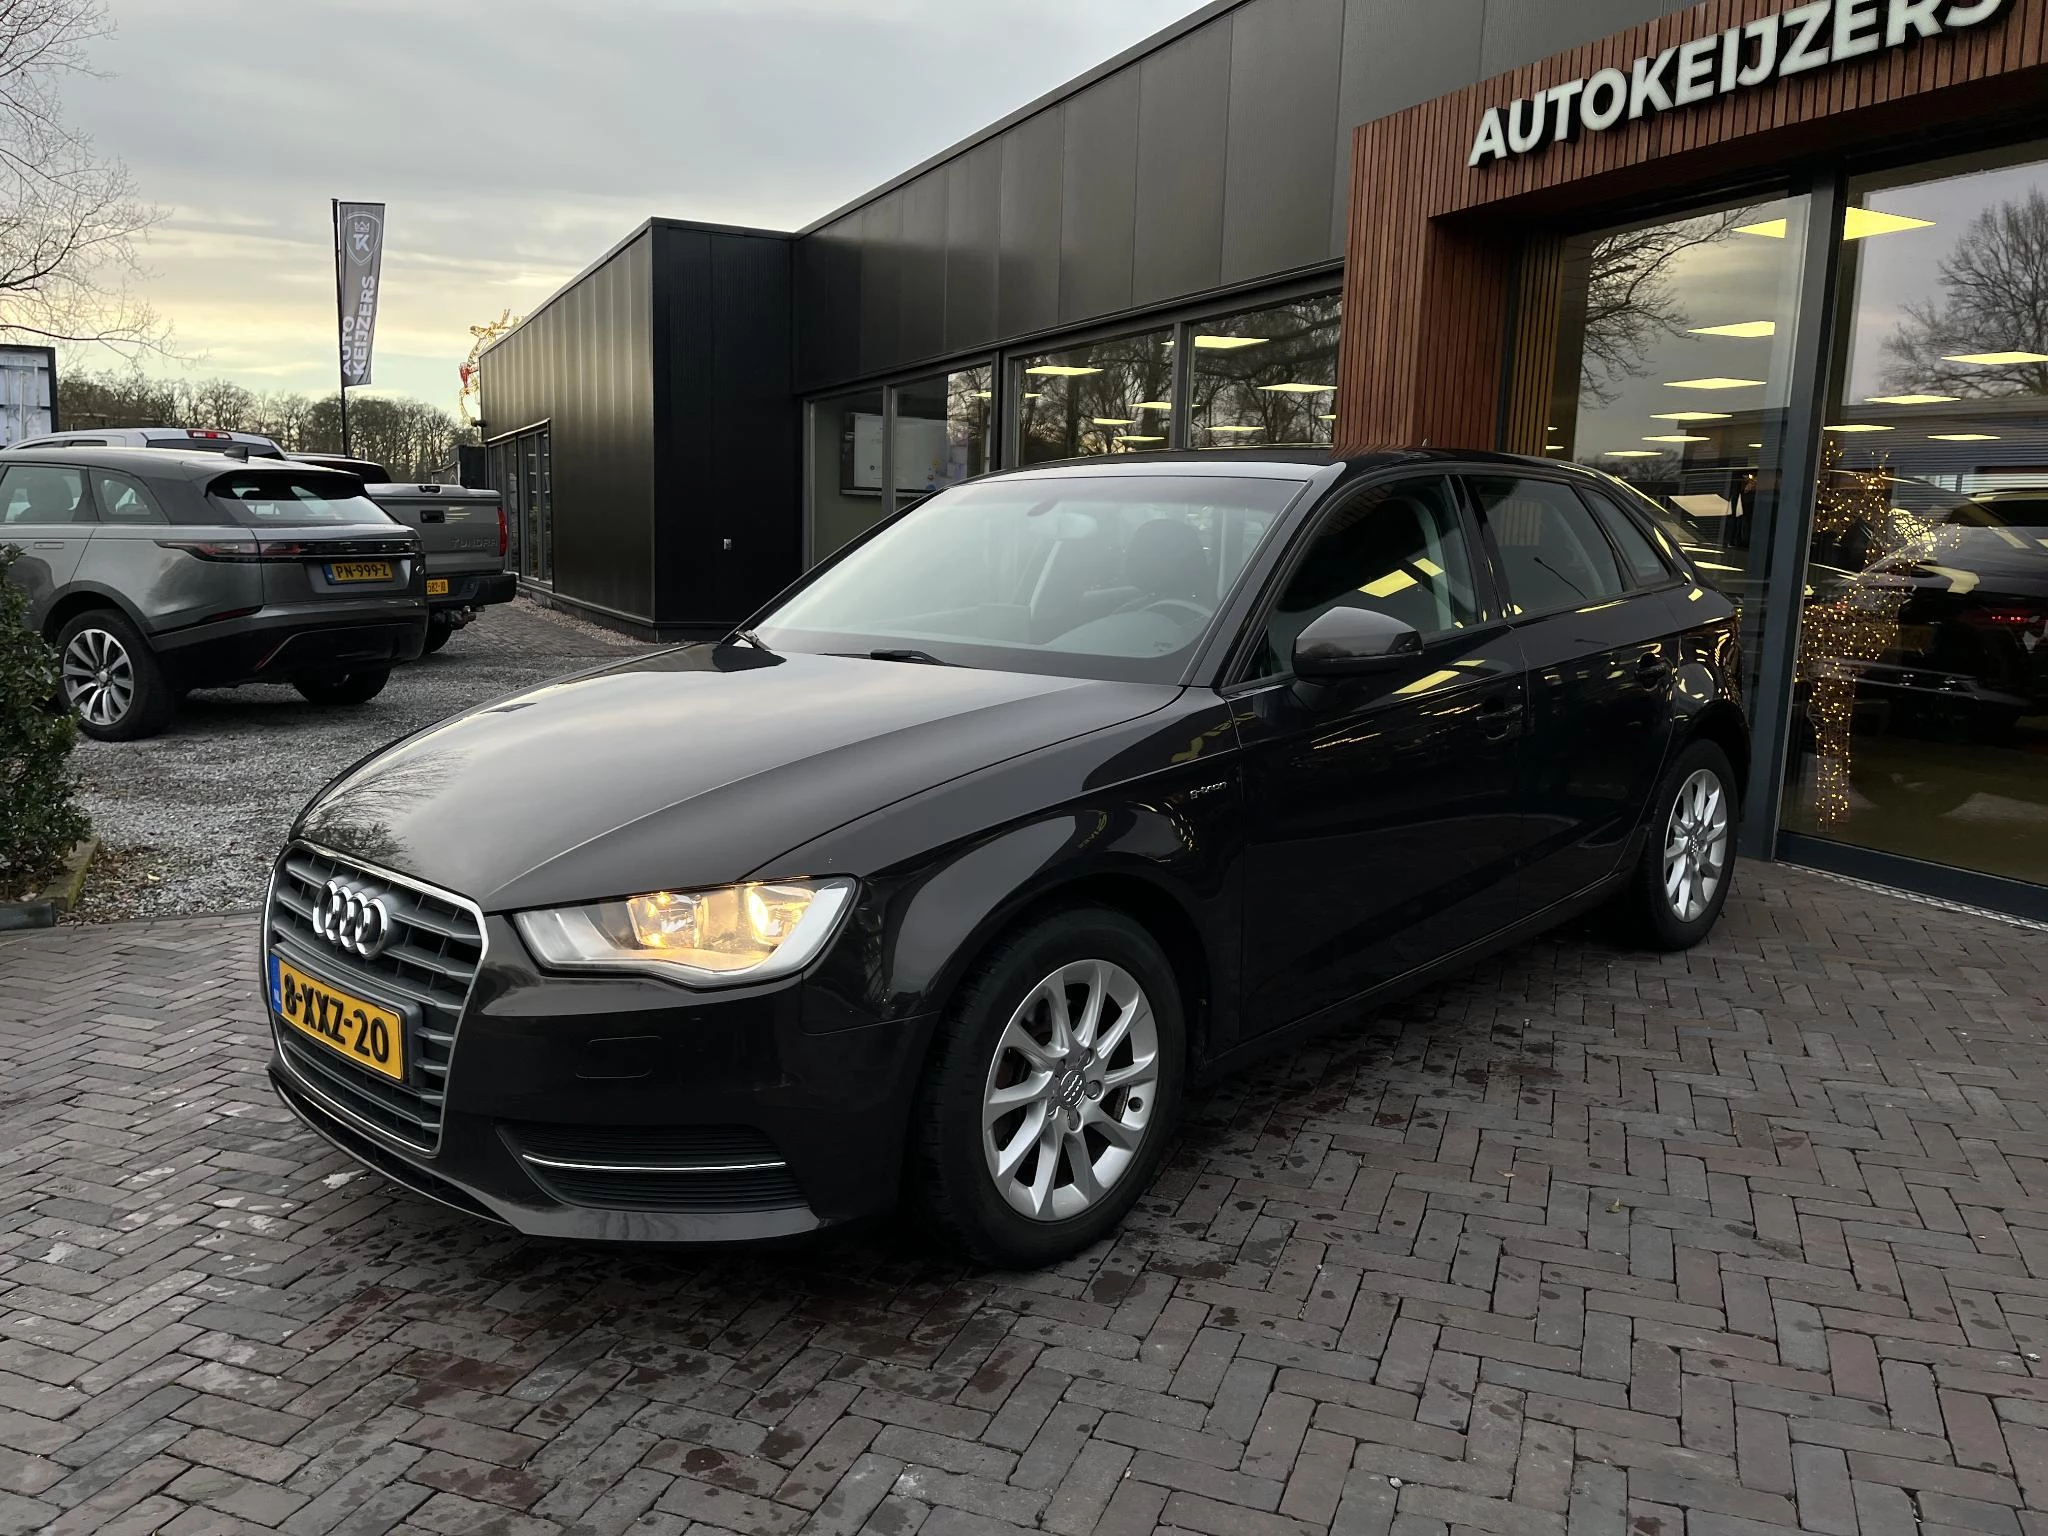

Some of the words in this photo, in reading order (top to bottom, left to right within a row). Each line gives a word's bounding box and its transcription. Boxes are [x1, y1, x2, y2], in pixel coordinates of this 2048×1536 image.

[343, 315, 355, 377] AUTO
[352, 275, 376, 376] KEIJZERS
[336, 564, 388, 578] PN-999-Z
[284, 973, 389, 1063] 8-XXZ-20
